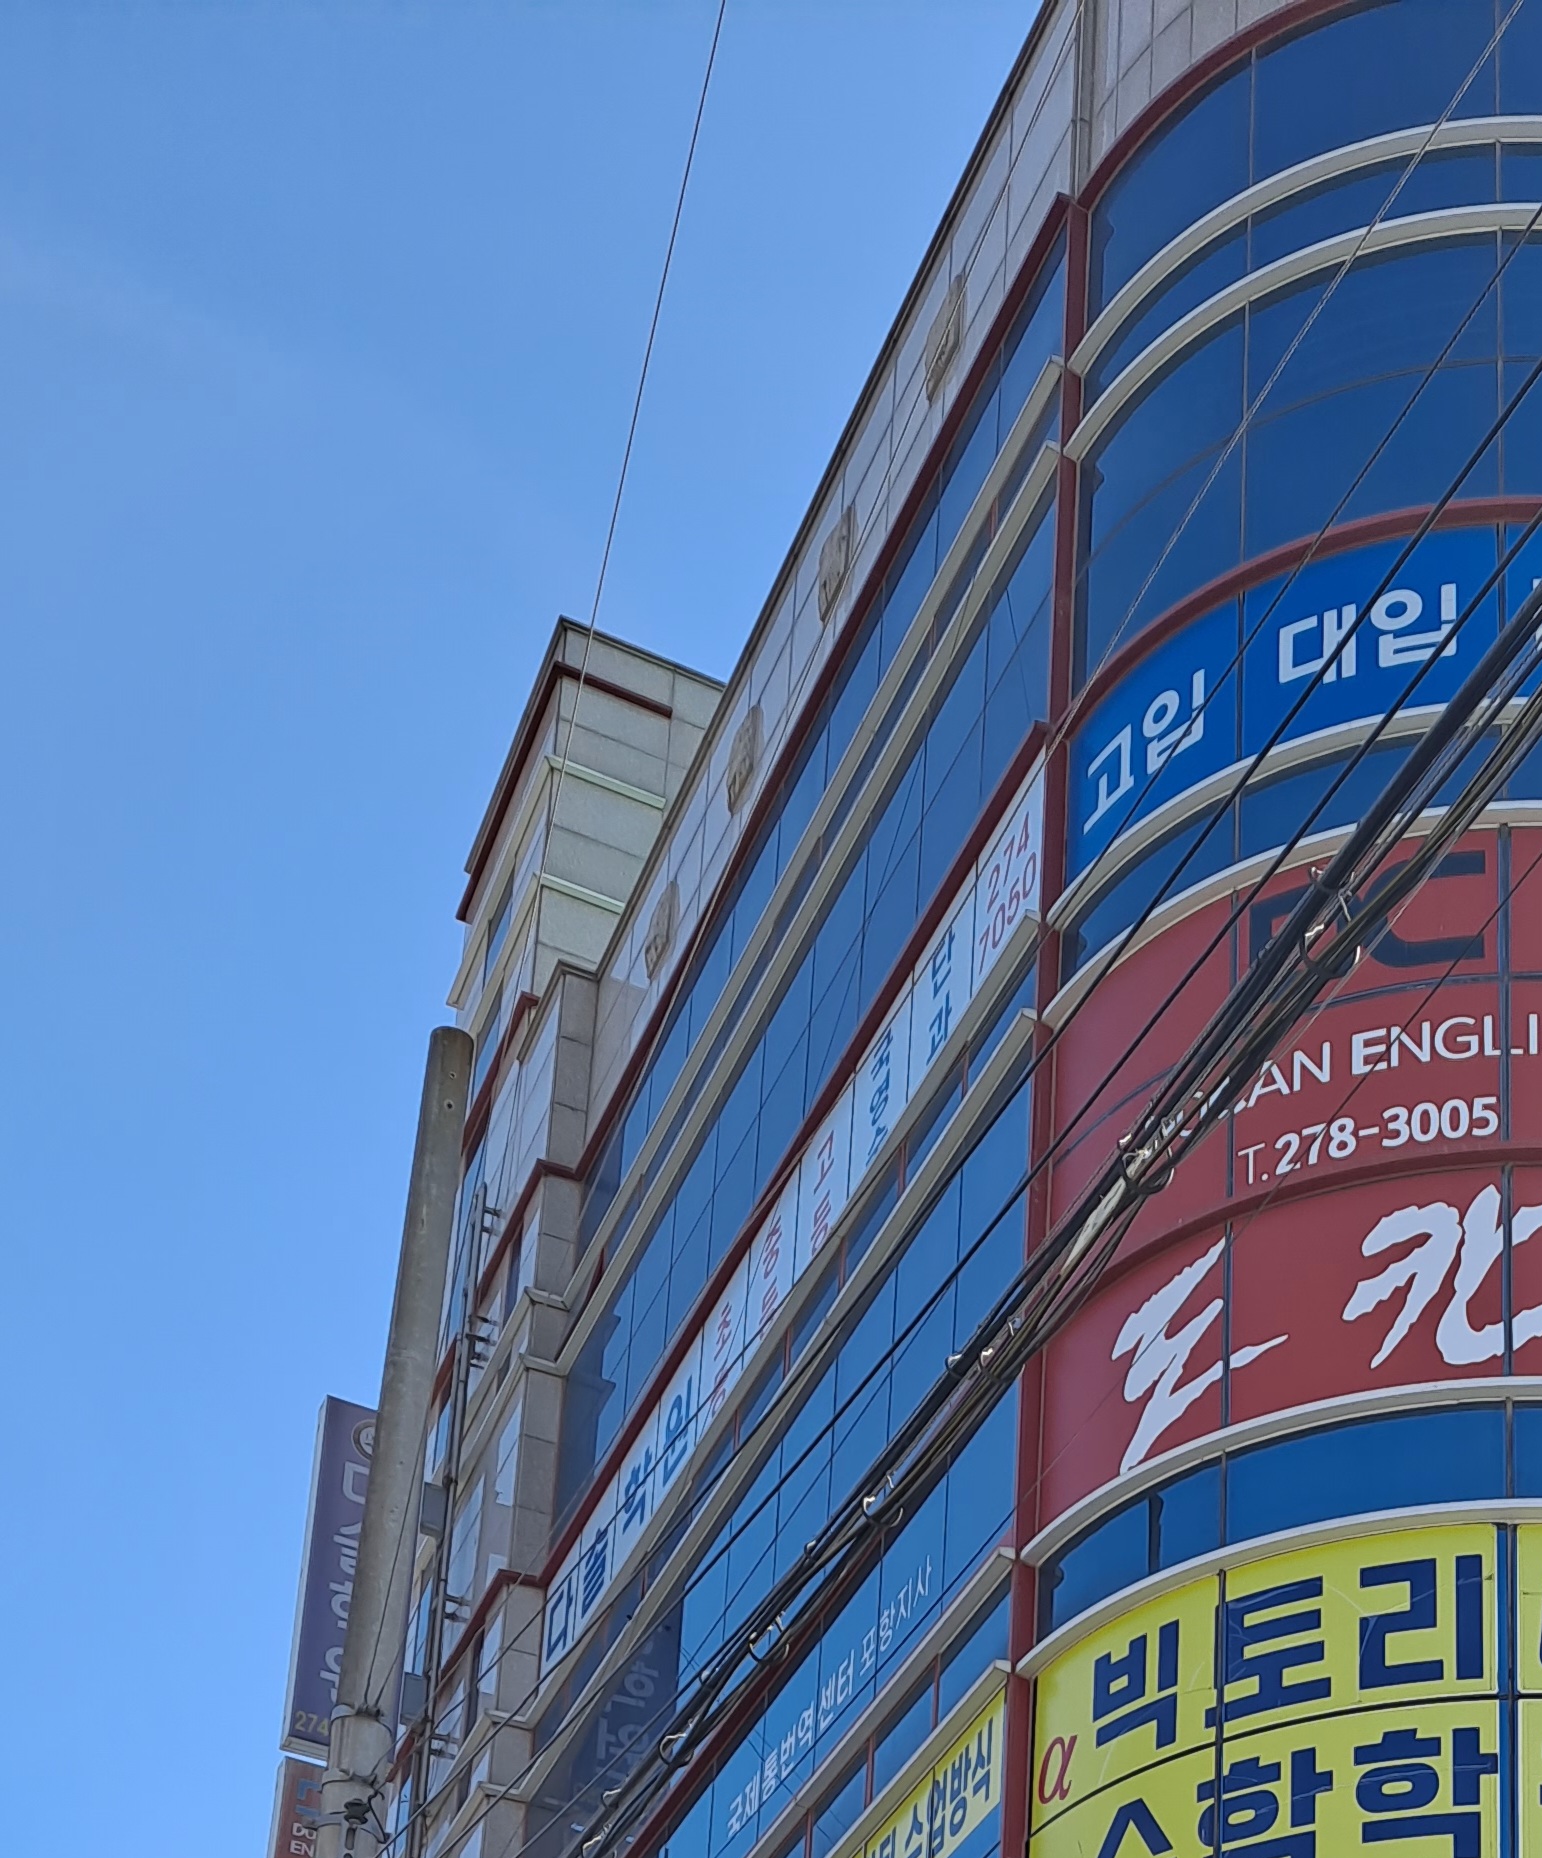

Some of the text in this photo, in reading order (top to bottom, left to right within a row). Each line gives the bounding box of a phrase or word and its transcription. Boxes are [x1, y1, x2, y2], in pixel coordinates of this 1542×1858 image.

[1083, 668, 1206, 834] 고입
[1277, 583, 1459, 686] 대입
[978, 852, 1037, 974] 7050
[987, 812, 1030, 905] 274
[1238, 1096, 1499, 1184] T.278-3005
[859, 1554, 932, 1679] 포항지사
